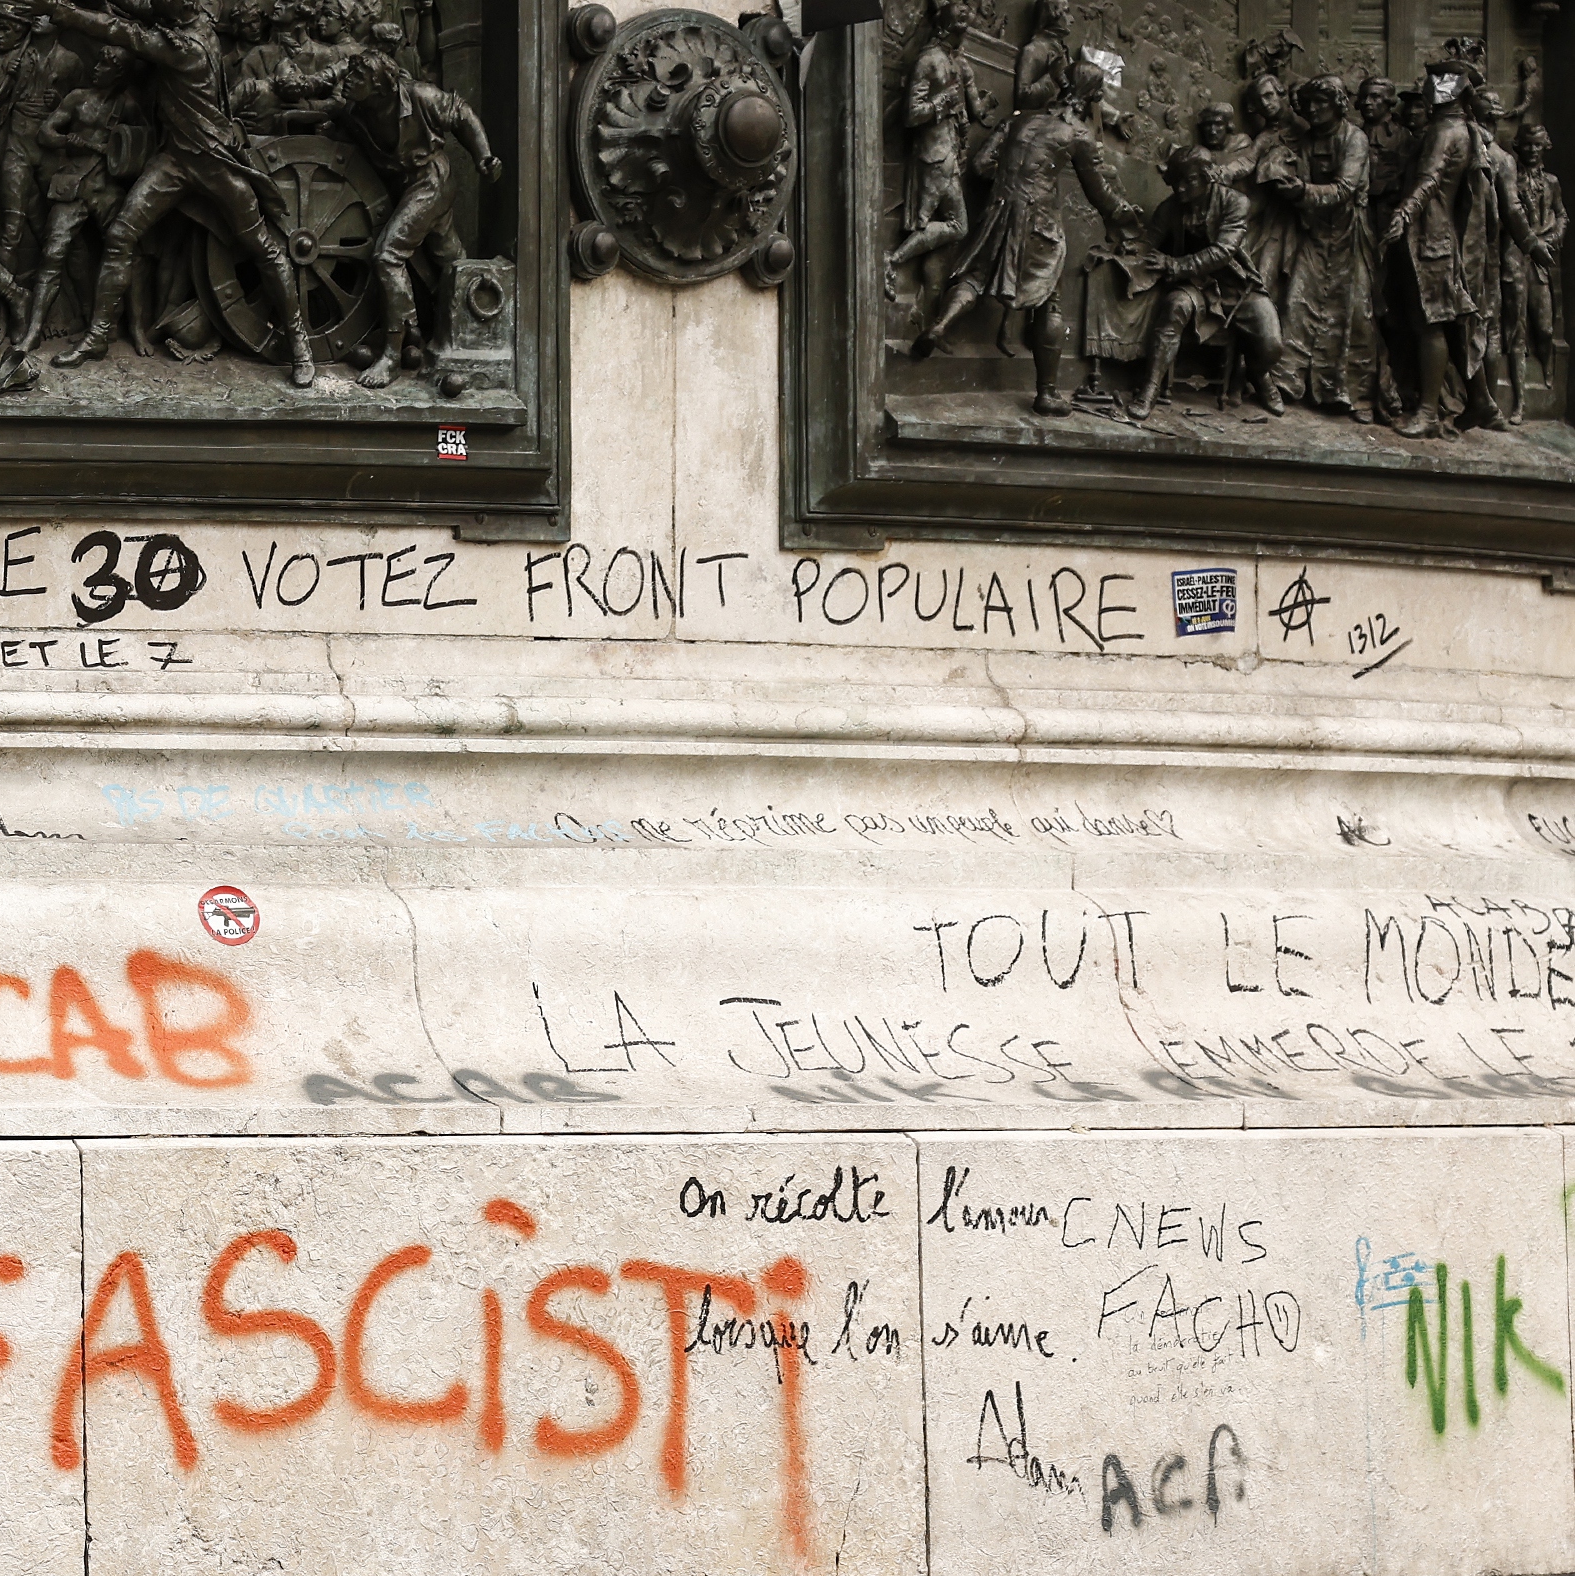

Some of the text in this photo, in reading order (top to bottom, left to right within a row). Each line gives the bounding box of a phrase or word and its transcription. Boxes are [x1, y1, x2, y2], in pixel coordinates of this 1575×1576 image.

[437, 443, 467, 455] CRA
[438, 430, 466, 444] FCK
[70, 530, 207, 628] 30
[241, 541, 478, 609] VOTEZ
[524, 543, 749, 622] FRONT
[1, 638, 194, 671] ET LE 7
[1348, 613, 1400, 654] 1312
[913, 909, 1149, 994] TOUT
[1221, 912, 1317, 998] LE
[1364, 908, 1575, 1010] MONDE
[533, 980, 1575, 1088] LA JEUNESSE EMMERDE LE
[679, 1175, 727, 1218] On
[747, 1164, 891, 1225] récolte
[1060, 1197, 1267, 1265] CNEWS
